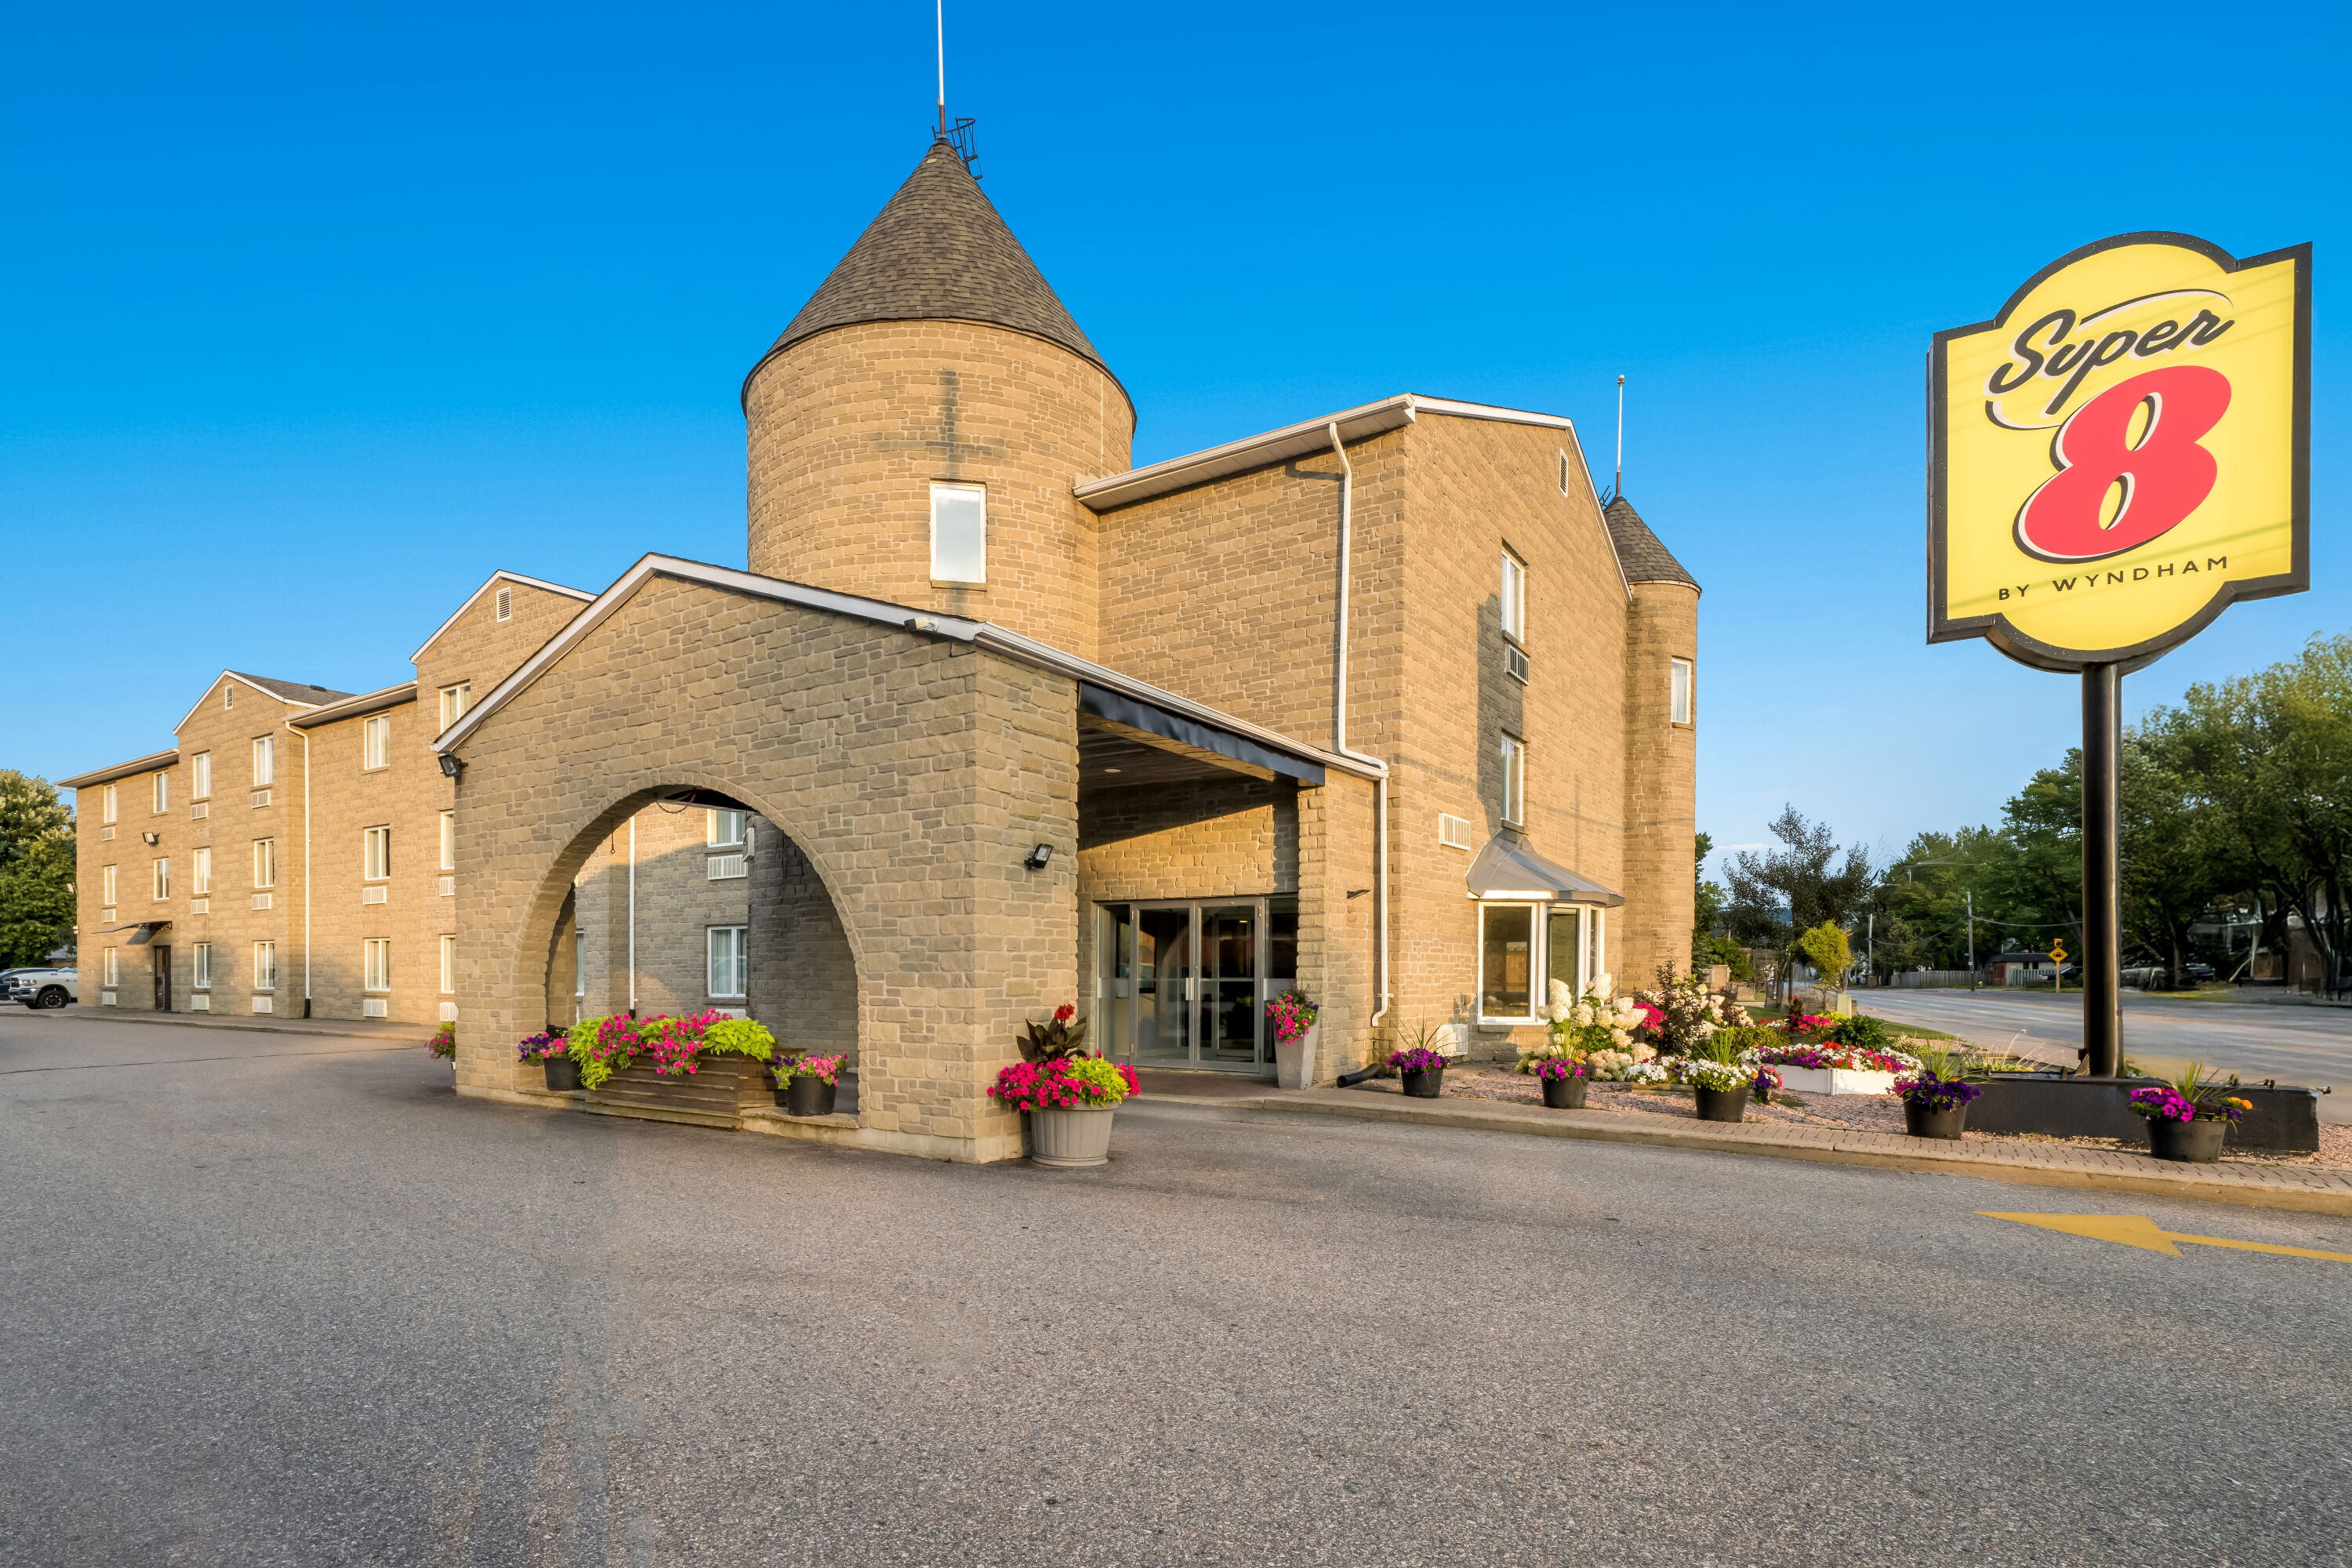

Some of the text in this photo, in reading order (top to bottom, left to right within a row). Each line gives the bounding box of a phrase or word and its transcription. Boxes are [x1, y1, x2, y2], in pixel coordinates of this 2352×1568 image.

[1984, 309, 2235, 417] Super
[2012, 365, 2233, 564] 8
[1998, 555, 2227, 601] BY WYNDHAM
